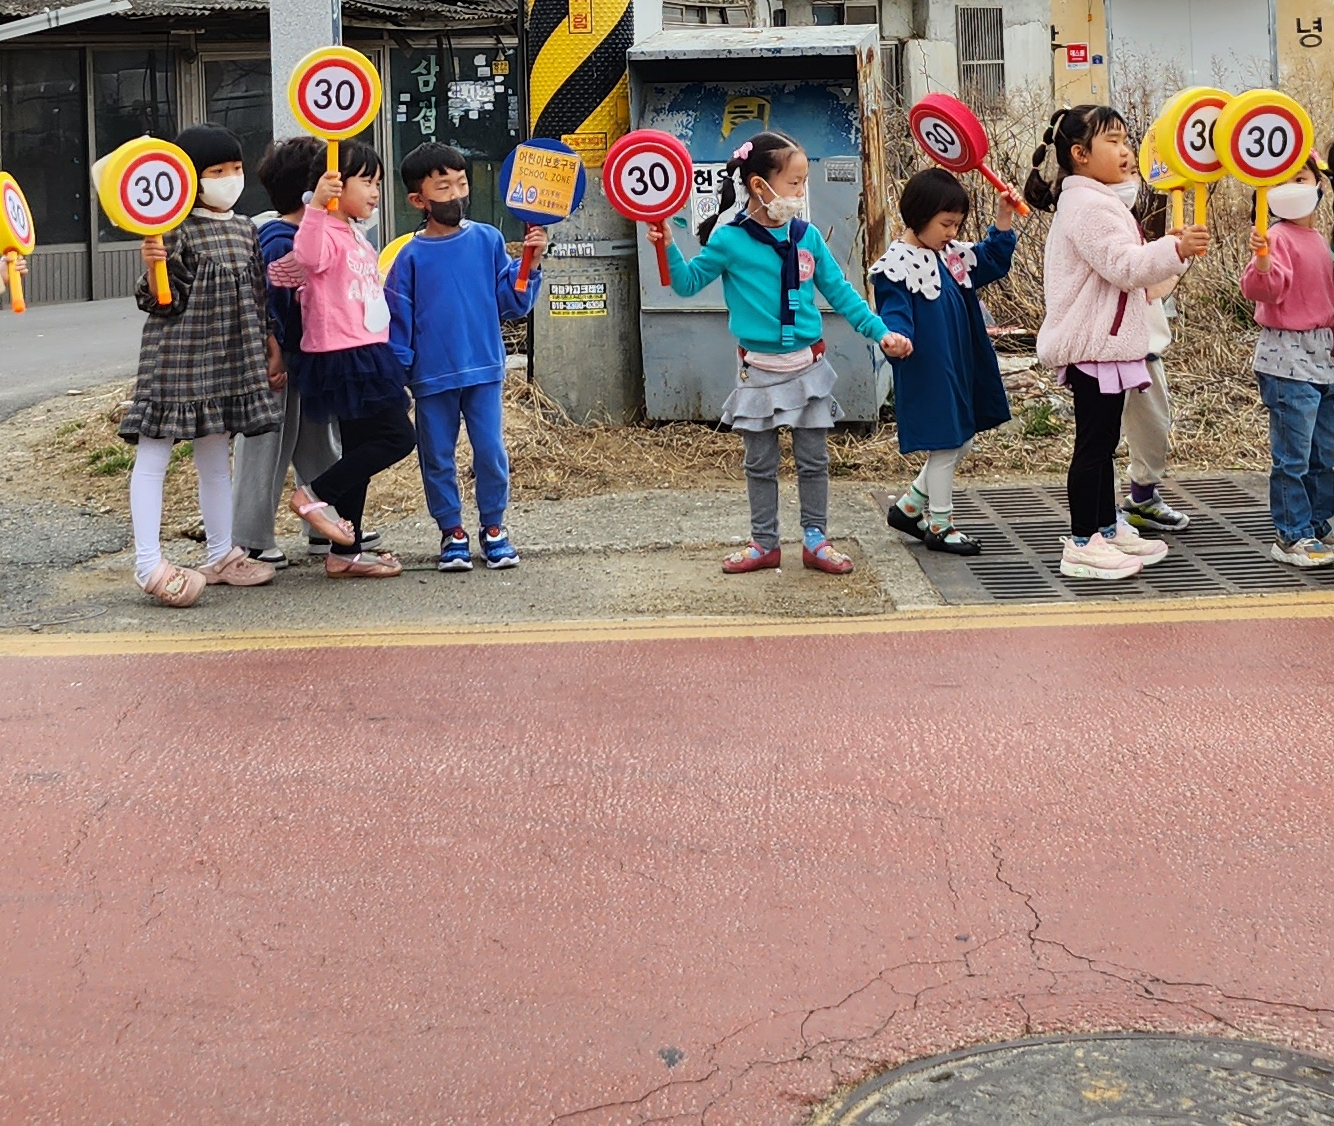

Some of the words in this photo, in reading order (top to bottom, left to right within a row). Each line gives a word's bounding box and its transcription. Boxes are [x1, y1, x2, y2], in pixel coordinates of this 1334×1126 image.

[313, 78, 356, 111] 30
[411, 55, 440, 143] 삼겹
[924, 122, 957, 155] 30
[1245, 125, 1288, 158] 30
[519, 151, 577, 172] 어린이보호구역
[519, 166, 551, 181] SCHOOL
[551, 173, 572, 185] ZONE
[134, 171, 174, 207] 30
[628, 161, 670, 196] 30
[8, 195, 26, 231] 30
